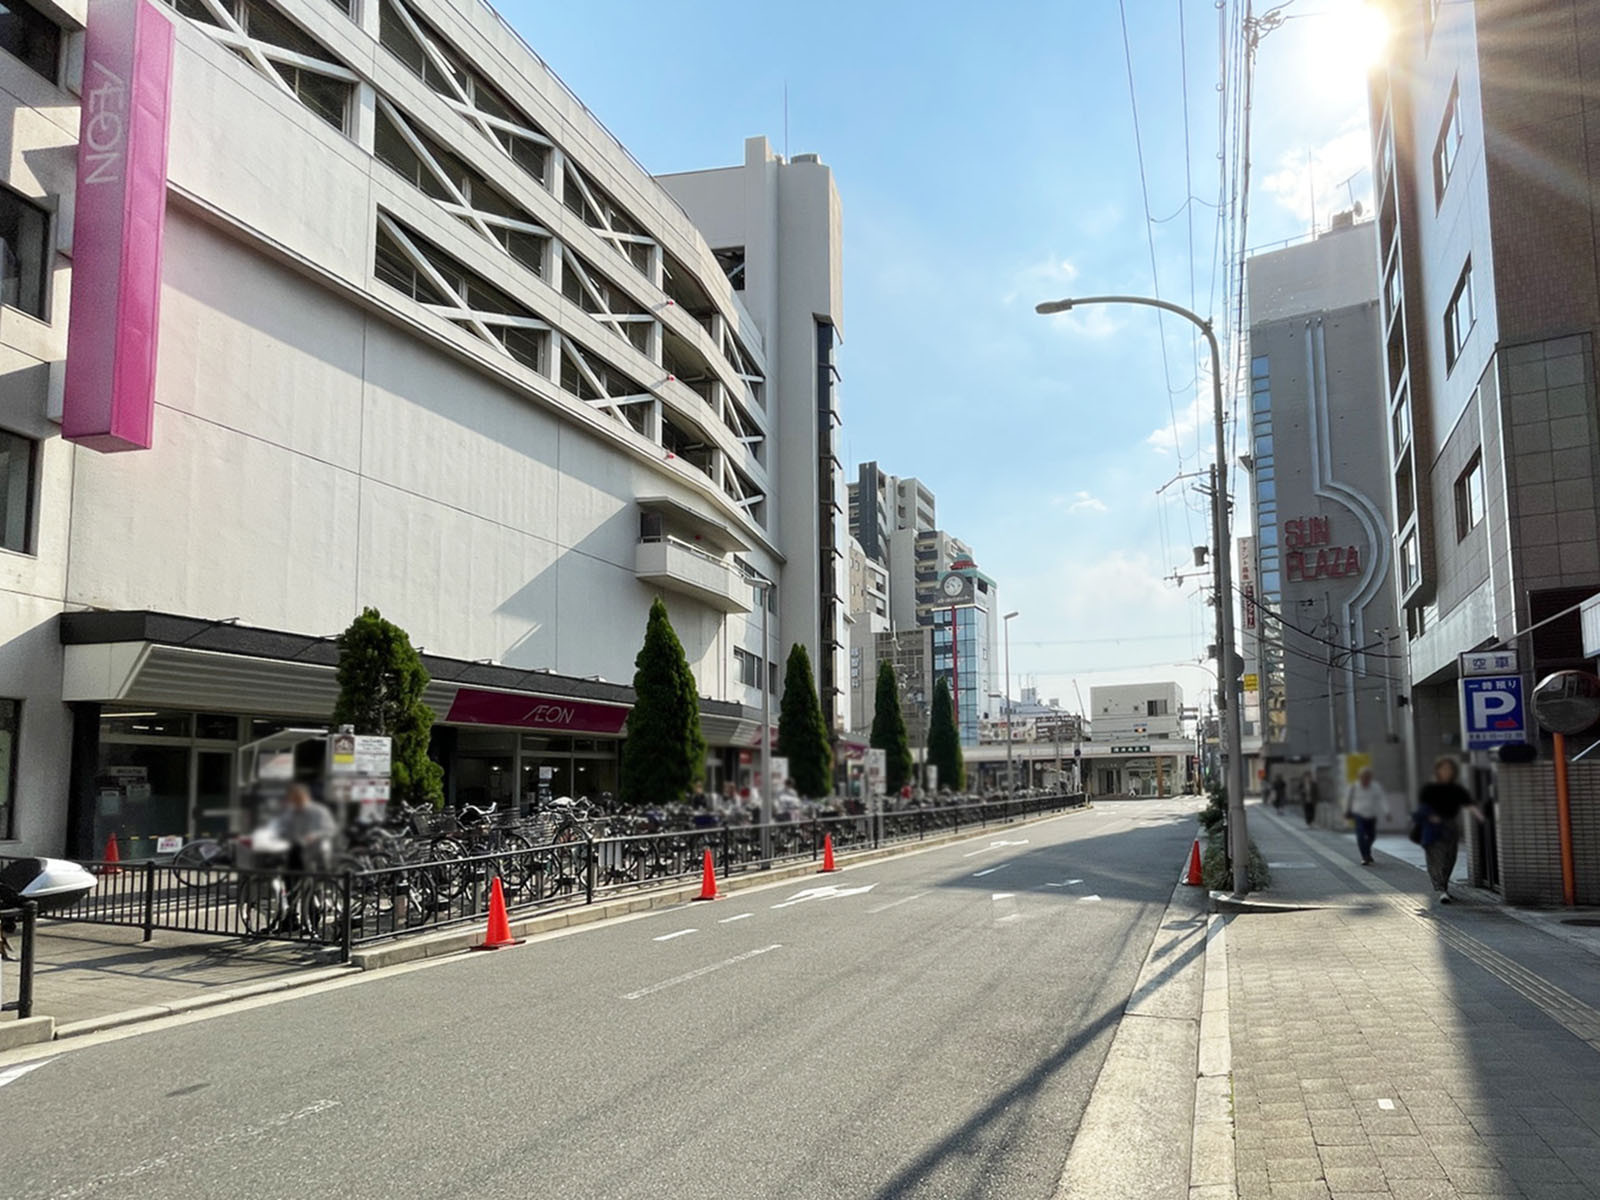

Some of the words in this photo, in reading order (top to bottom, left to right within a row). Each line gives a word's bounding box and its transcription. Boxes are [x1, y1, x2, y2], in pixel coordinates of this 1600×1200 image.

[1284, 516, 1330, 548] SUN
[1286, 546, 1360, 581] PLAZA
[1472, 656, 1509, 671] 空車
[1472, 690, 1517, 729] P
